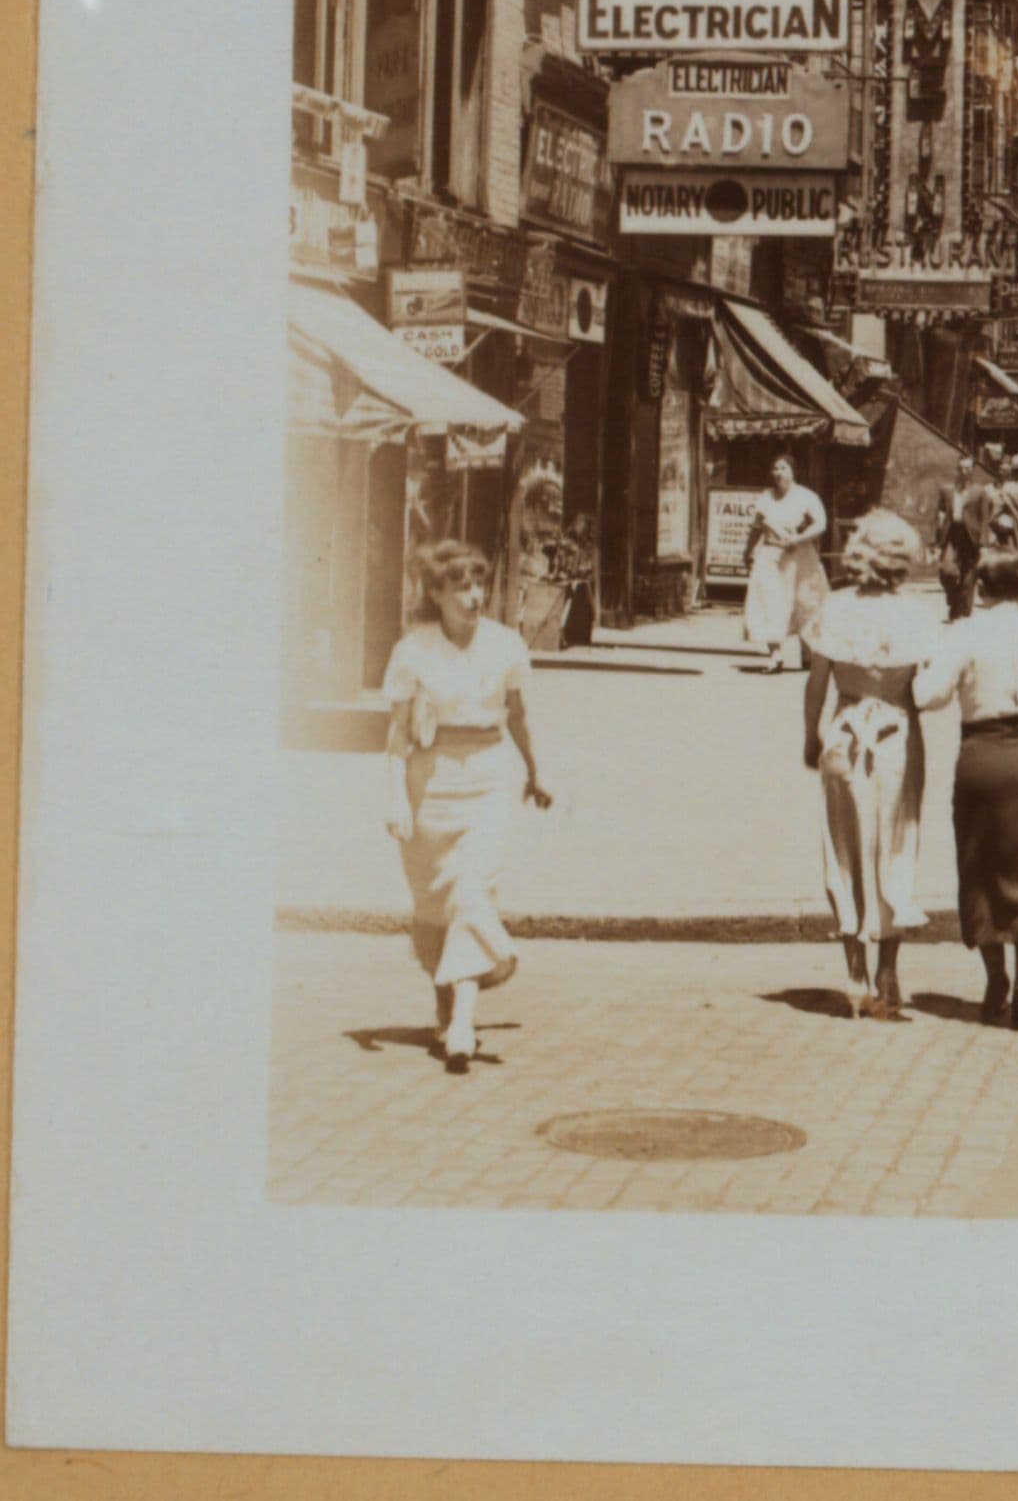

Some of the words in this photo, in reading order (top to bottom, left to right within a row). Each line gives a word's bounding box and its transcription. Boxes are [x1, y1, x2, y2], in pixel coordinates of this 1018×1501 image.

[672, 65, 789, 94] ELECTRICIAN
[642, 109, 813, 156] RADIO
[626, 184, 704, 218] NOTARY
[752, 188, 832, 221] PUBLIC
[403, 330, 453, 343] CASH
